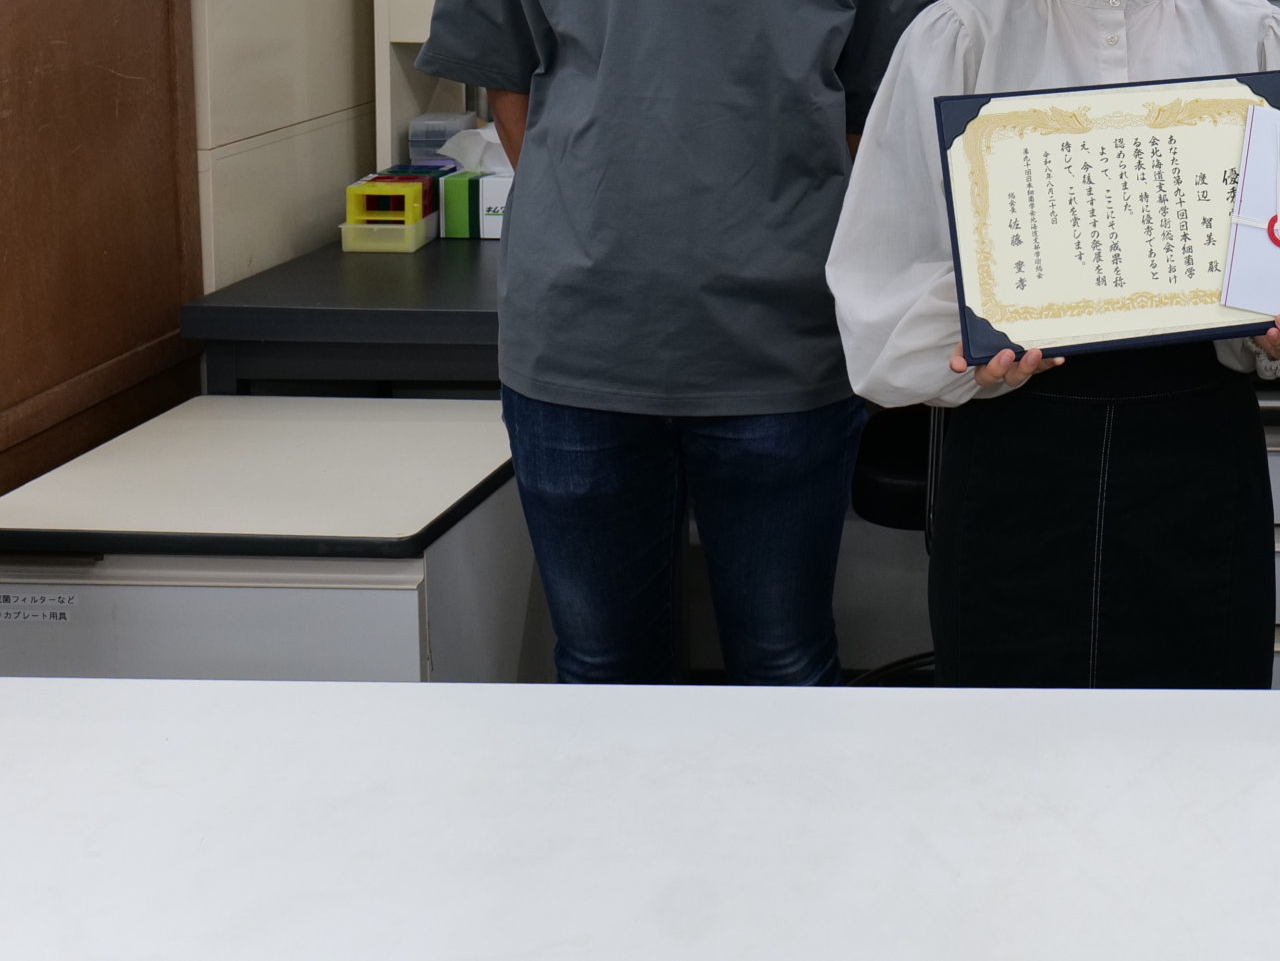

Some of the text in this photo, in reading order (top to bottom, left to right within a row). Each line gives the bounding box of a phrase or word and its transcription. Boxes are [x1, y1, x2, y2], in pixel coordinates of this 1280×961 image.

[1222, 167, 1239, 216] 優秀
[0, 595, 75, 605] 菌フィルターなど
[0, 611, 67, 621] カプレート用具
